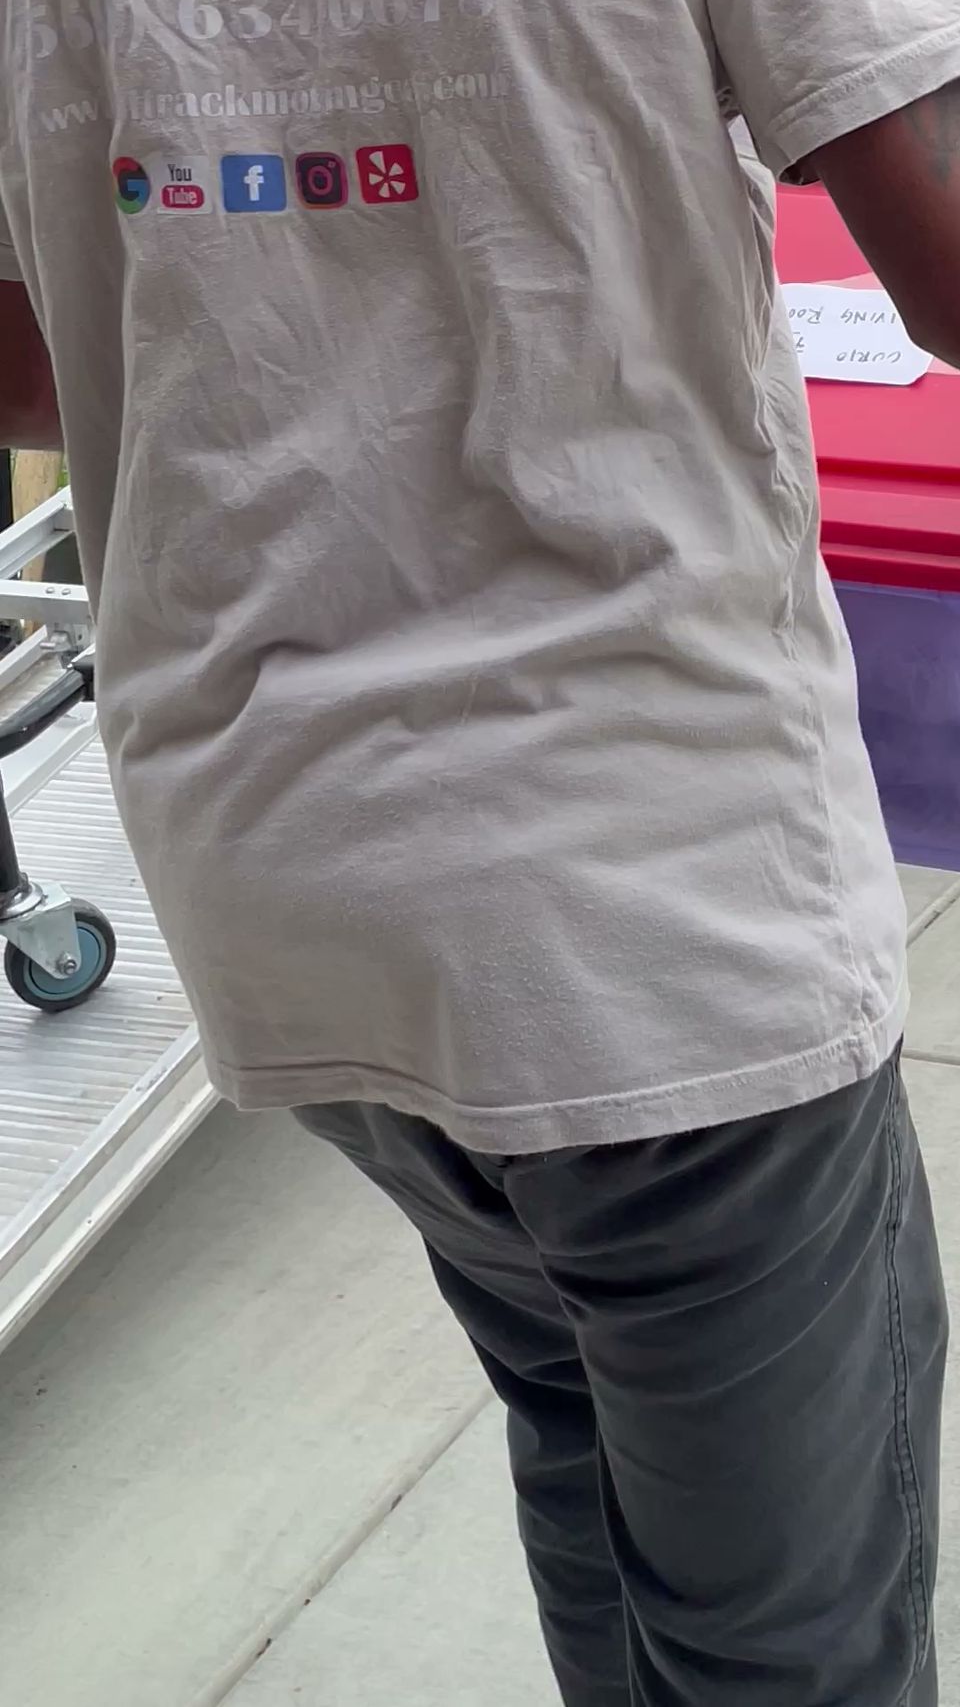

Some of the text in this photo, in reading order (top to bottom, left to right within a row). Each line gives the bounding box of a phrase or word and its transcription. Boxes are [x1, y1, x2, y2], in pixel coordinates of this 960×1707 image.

[167, 164, 192, 182] You
[166, 187, 198, 205] Tube
[840, 307, 897, 325] IVING
[836, 349, 902, 364] CURIO
